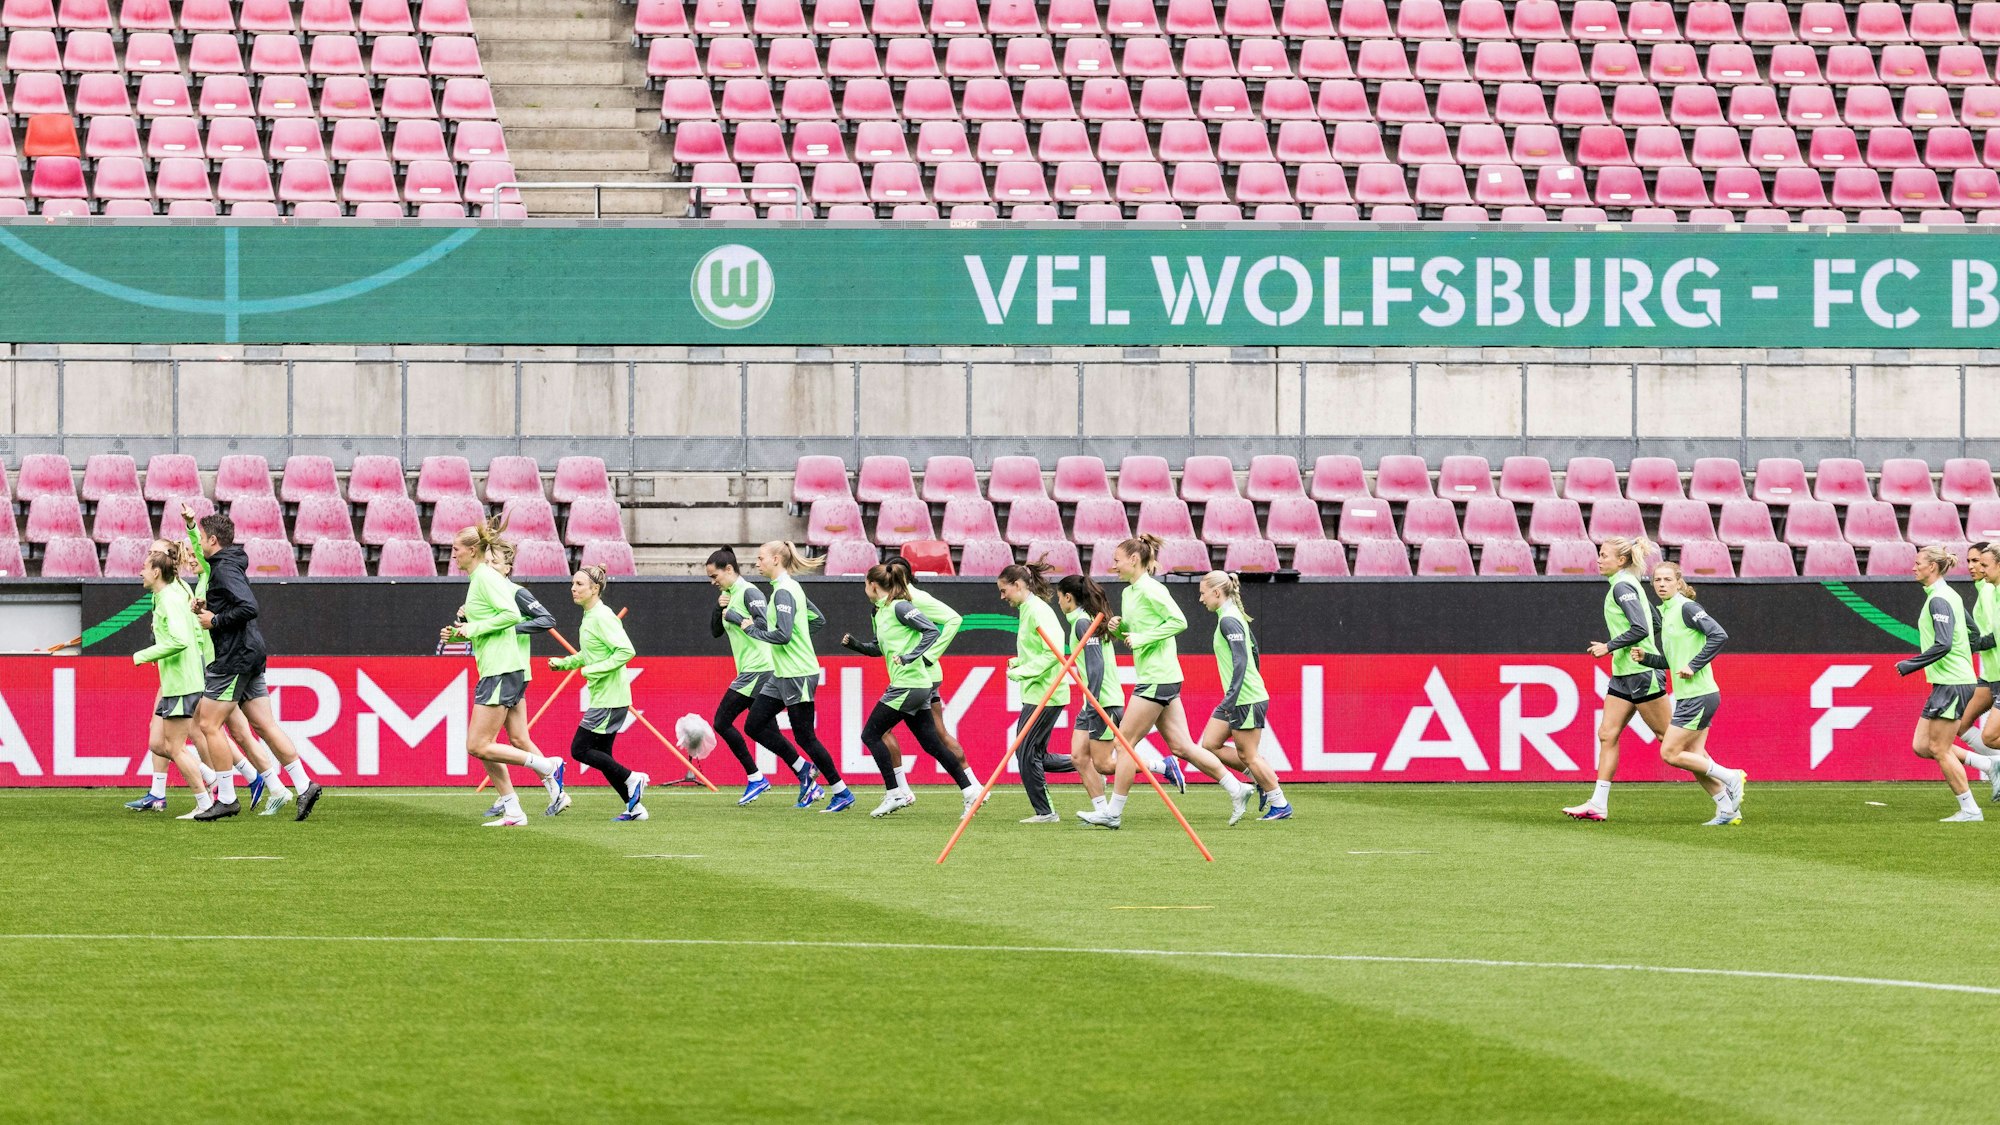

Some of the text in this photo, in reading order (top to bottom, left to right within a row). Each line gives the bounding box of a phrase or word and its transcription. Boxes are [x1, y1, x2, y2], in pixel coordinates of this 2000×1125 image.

[963, 254, 2000, 330] VFL WOLFSBURG - FC B
[0, 667, 469, 776] LRM
